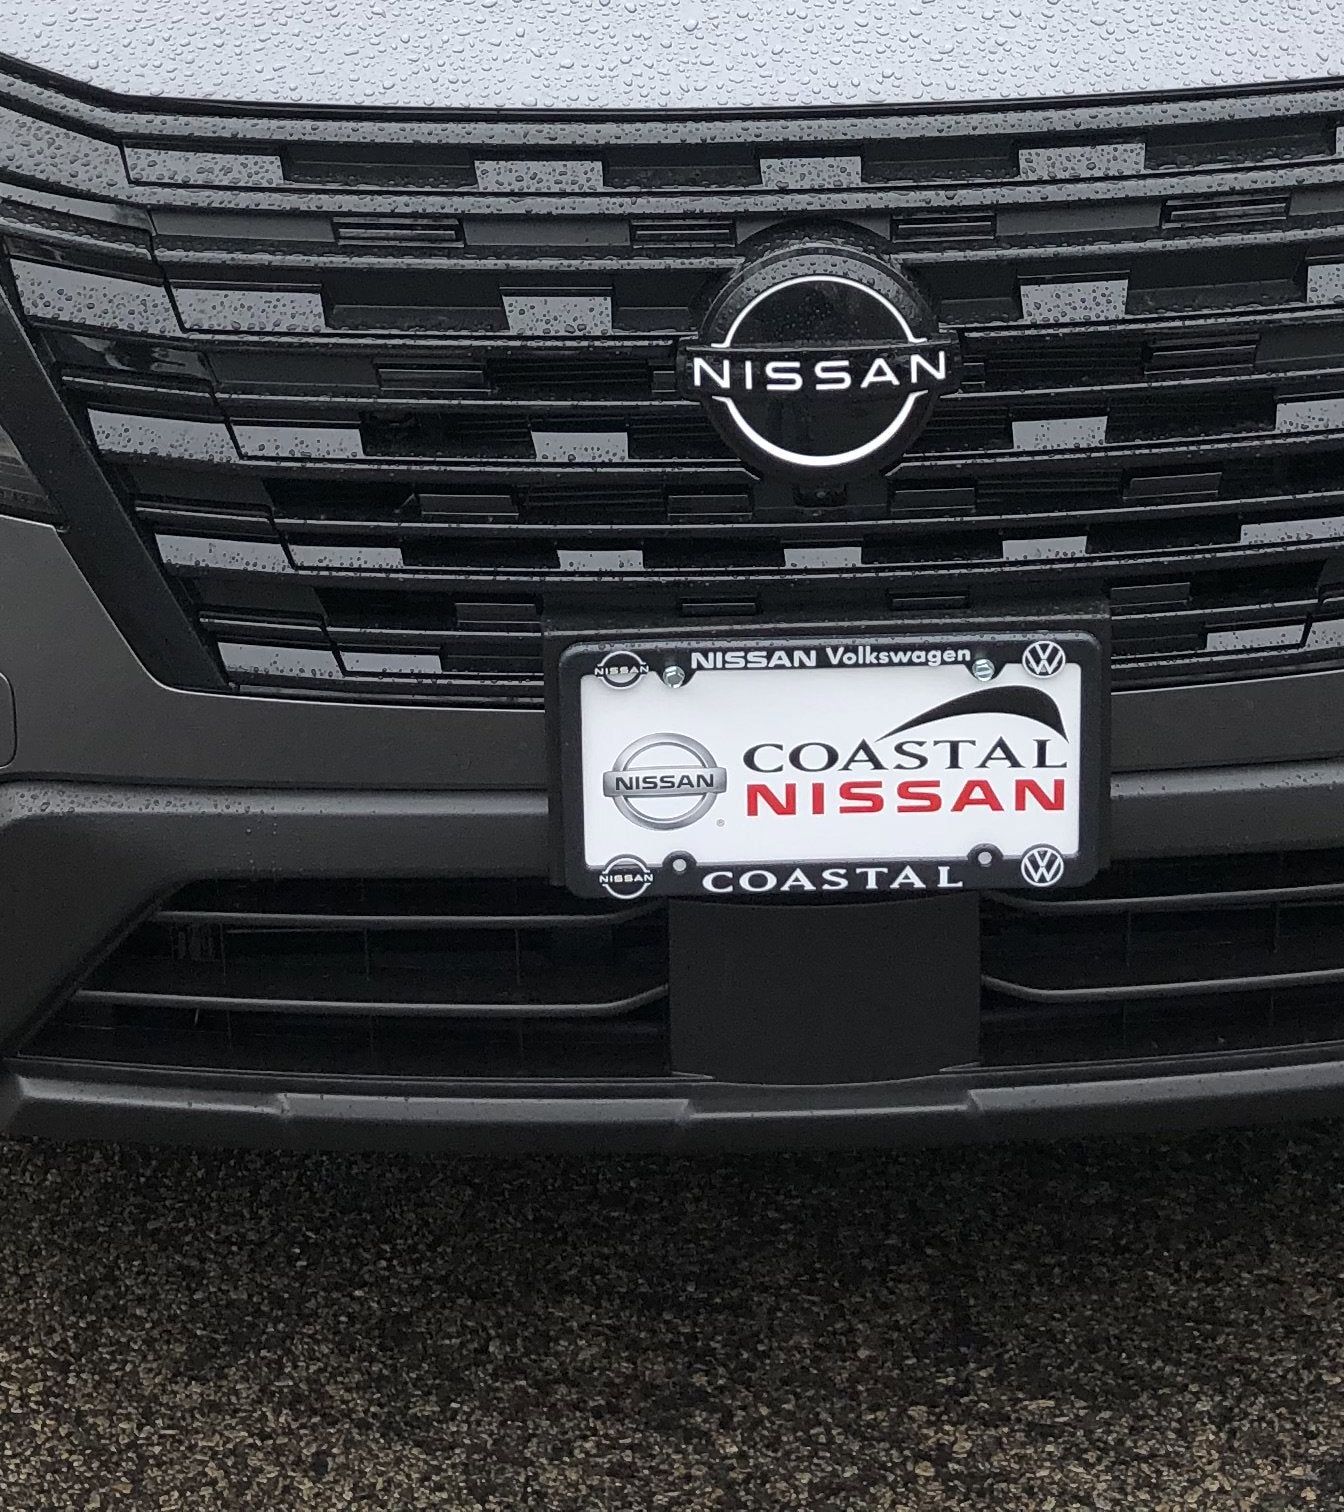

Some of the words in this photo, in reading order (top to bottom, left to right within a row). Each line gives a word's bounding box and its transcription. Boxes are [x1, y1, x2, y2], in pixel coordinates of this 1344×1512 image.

[692, 350, 946, 391] NISSAN
[594, 665, 649, 676] NISSAN
[690, 649, 817, 670] NISSAN
[826, 646, 971, 667] Volkswagen
[742, 736, 1069, 773] COASTAL
[614, 772, 715, 792] NISSAN
[746, 778, 1066, 817] NISSAN
[599, 873, 653, 884] NISSAN
[701, 864, 964, 894] COASTAL
